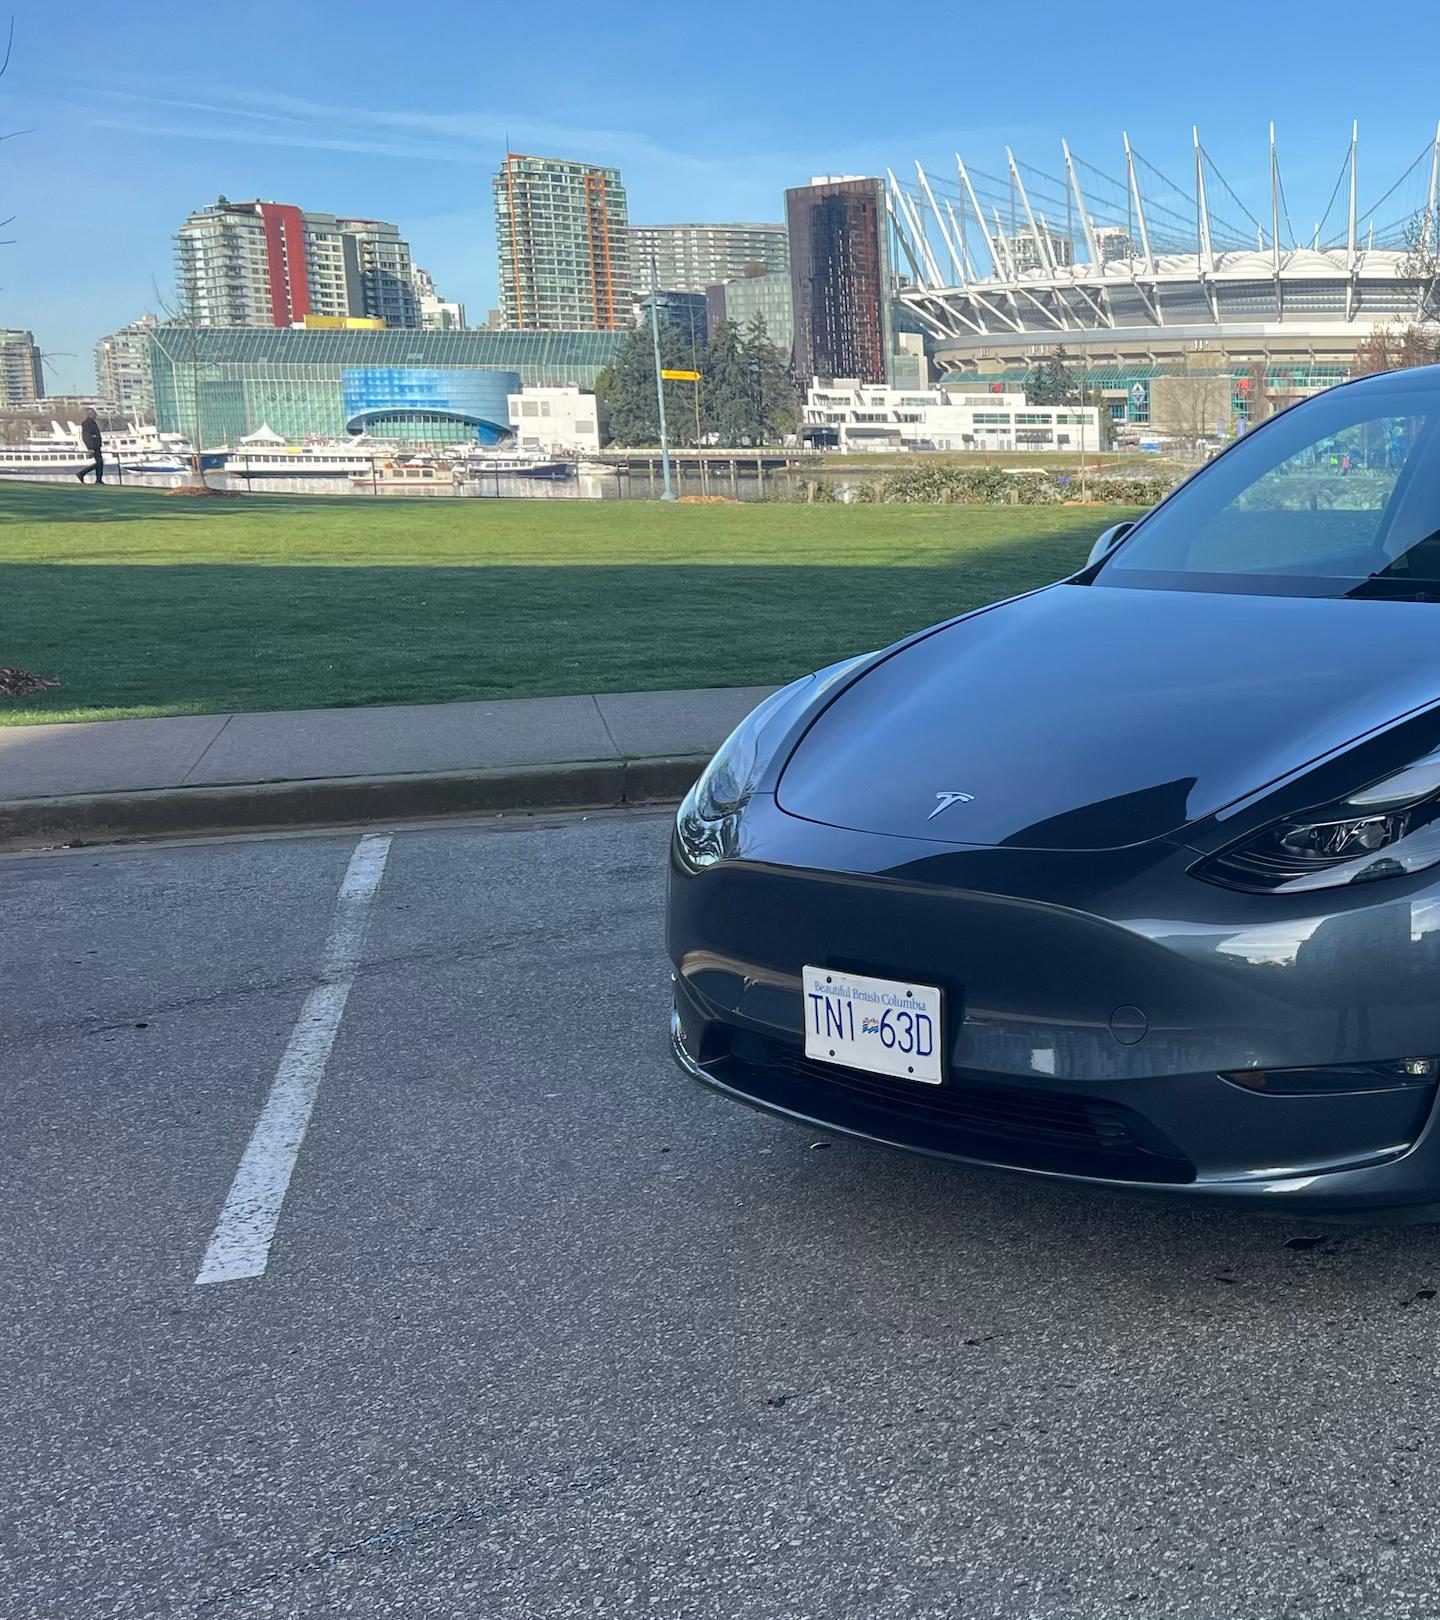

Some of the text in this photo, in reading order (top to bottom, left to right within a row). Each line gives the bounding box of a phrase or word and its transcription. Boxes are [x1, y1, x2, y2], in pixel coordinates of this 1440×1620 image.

[814, 981, 926, 1011] Beautiful British Columbia
[808, 993, 933, 1056] TN1 63D
